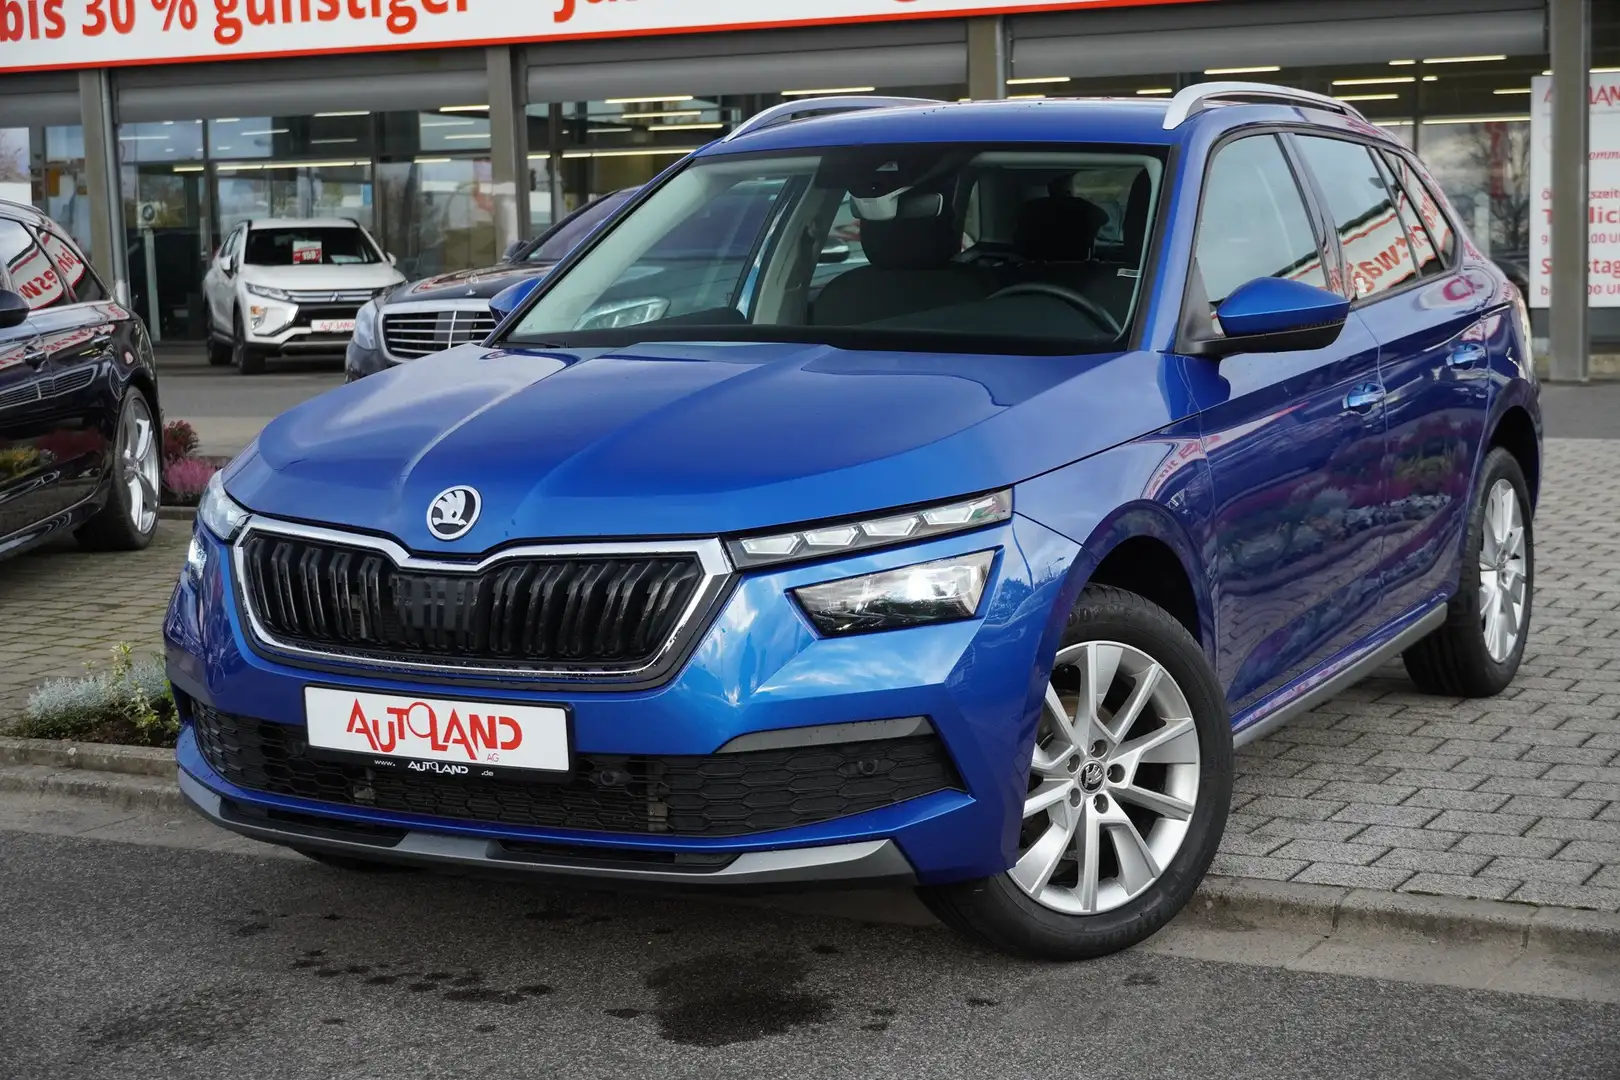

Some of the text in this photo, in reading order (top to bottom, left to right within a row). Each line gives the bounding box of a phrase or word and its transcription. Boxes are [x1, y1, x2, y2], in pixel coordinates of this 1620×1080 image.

[0, 0, 66, 42] bis
[81, 0, 136, 37] 30
[346, 698, 523, 761] AUTOLAND
[374, 759, 396, 767] www.
[408, 761, 469, 775] AUTOLAND
[487, 752, 499, 763] AG
